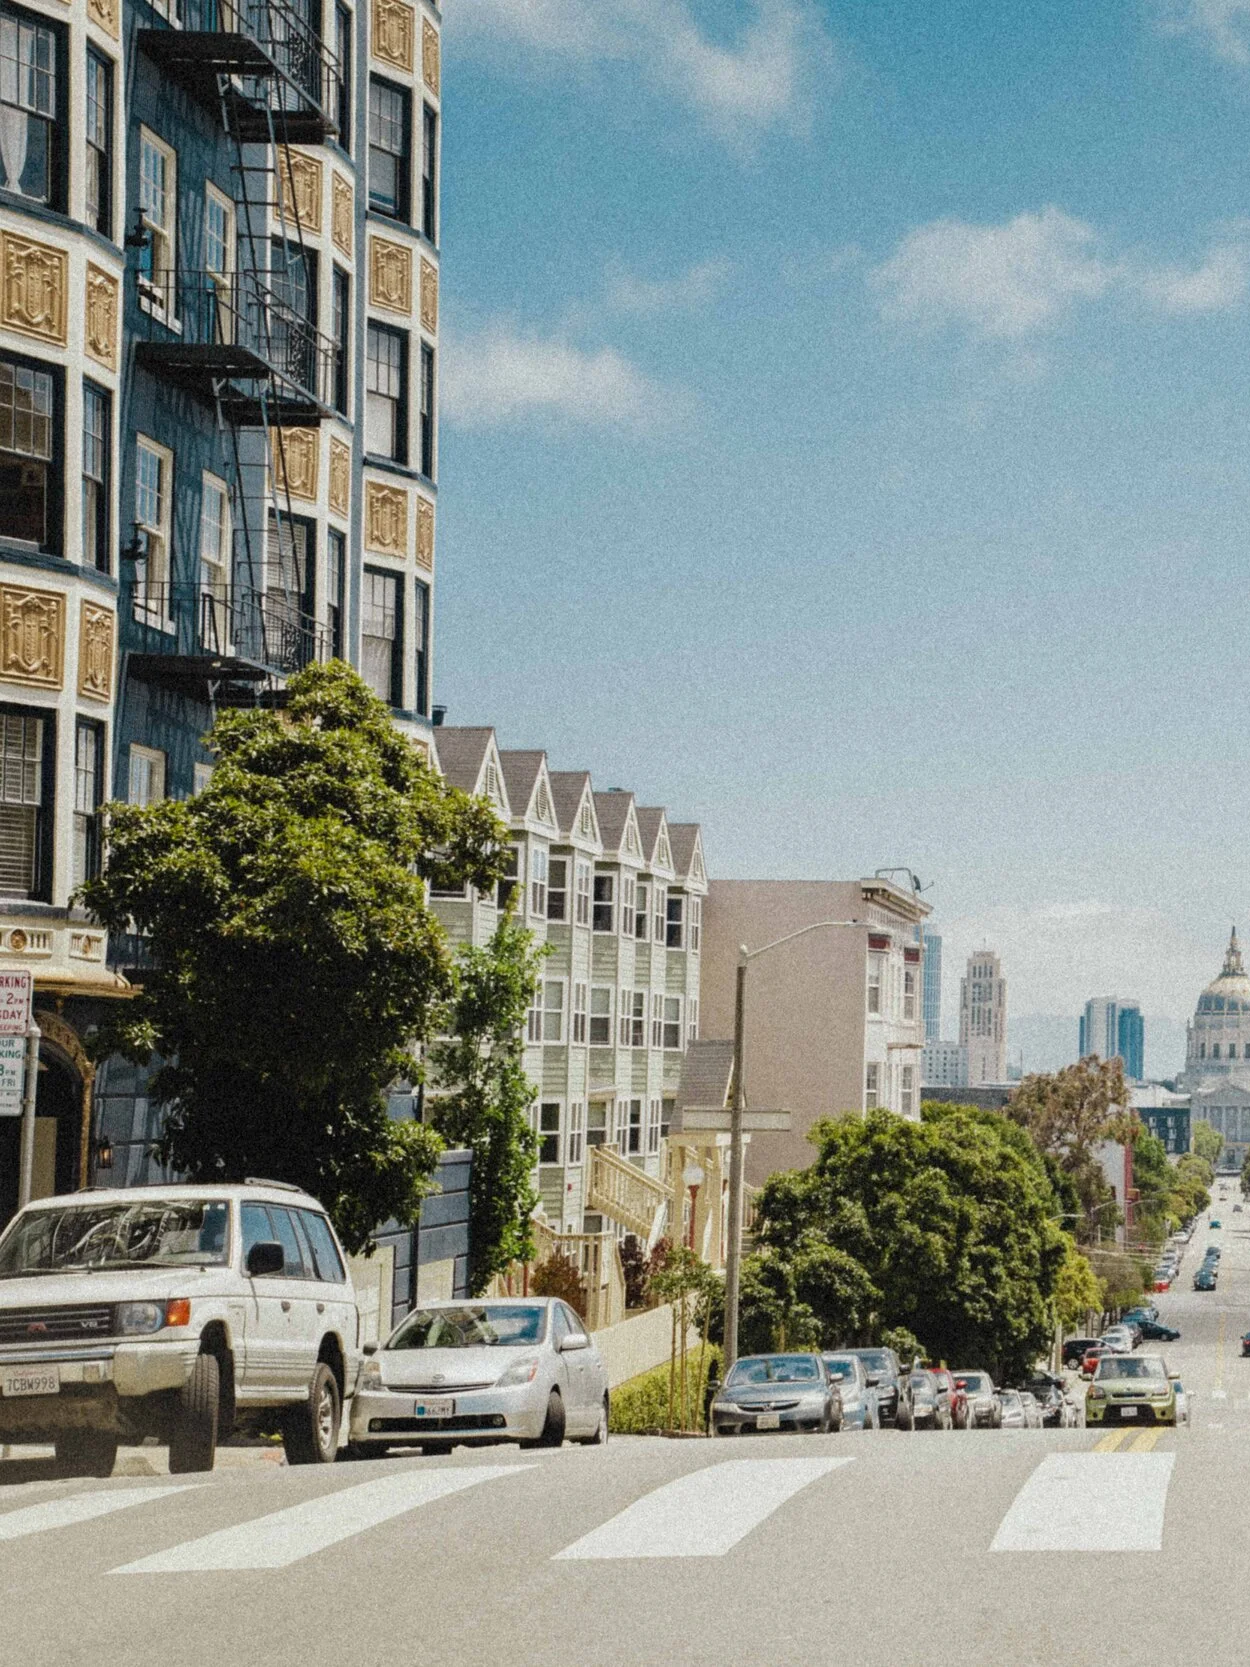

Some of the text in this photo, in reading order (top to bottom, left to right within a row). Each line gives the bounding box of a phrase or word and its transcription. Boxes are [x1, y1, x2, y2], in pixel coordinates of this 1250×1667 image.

[0, 1010, 22, 1020] DAY
[1, 1078, 16, 1087] FRI
[7, 1377, 56, 1392] 7CBW998
